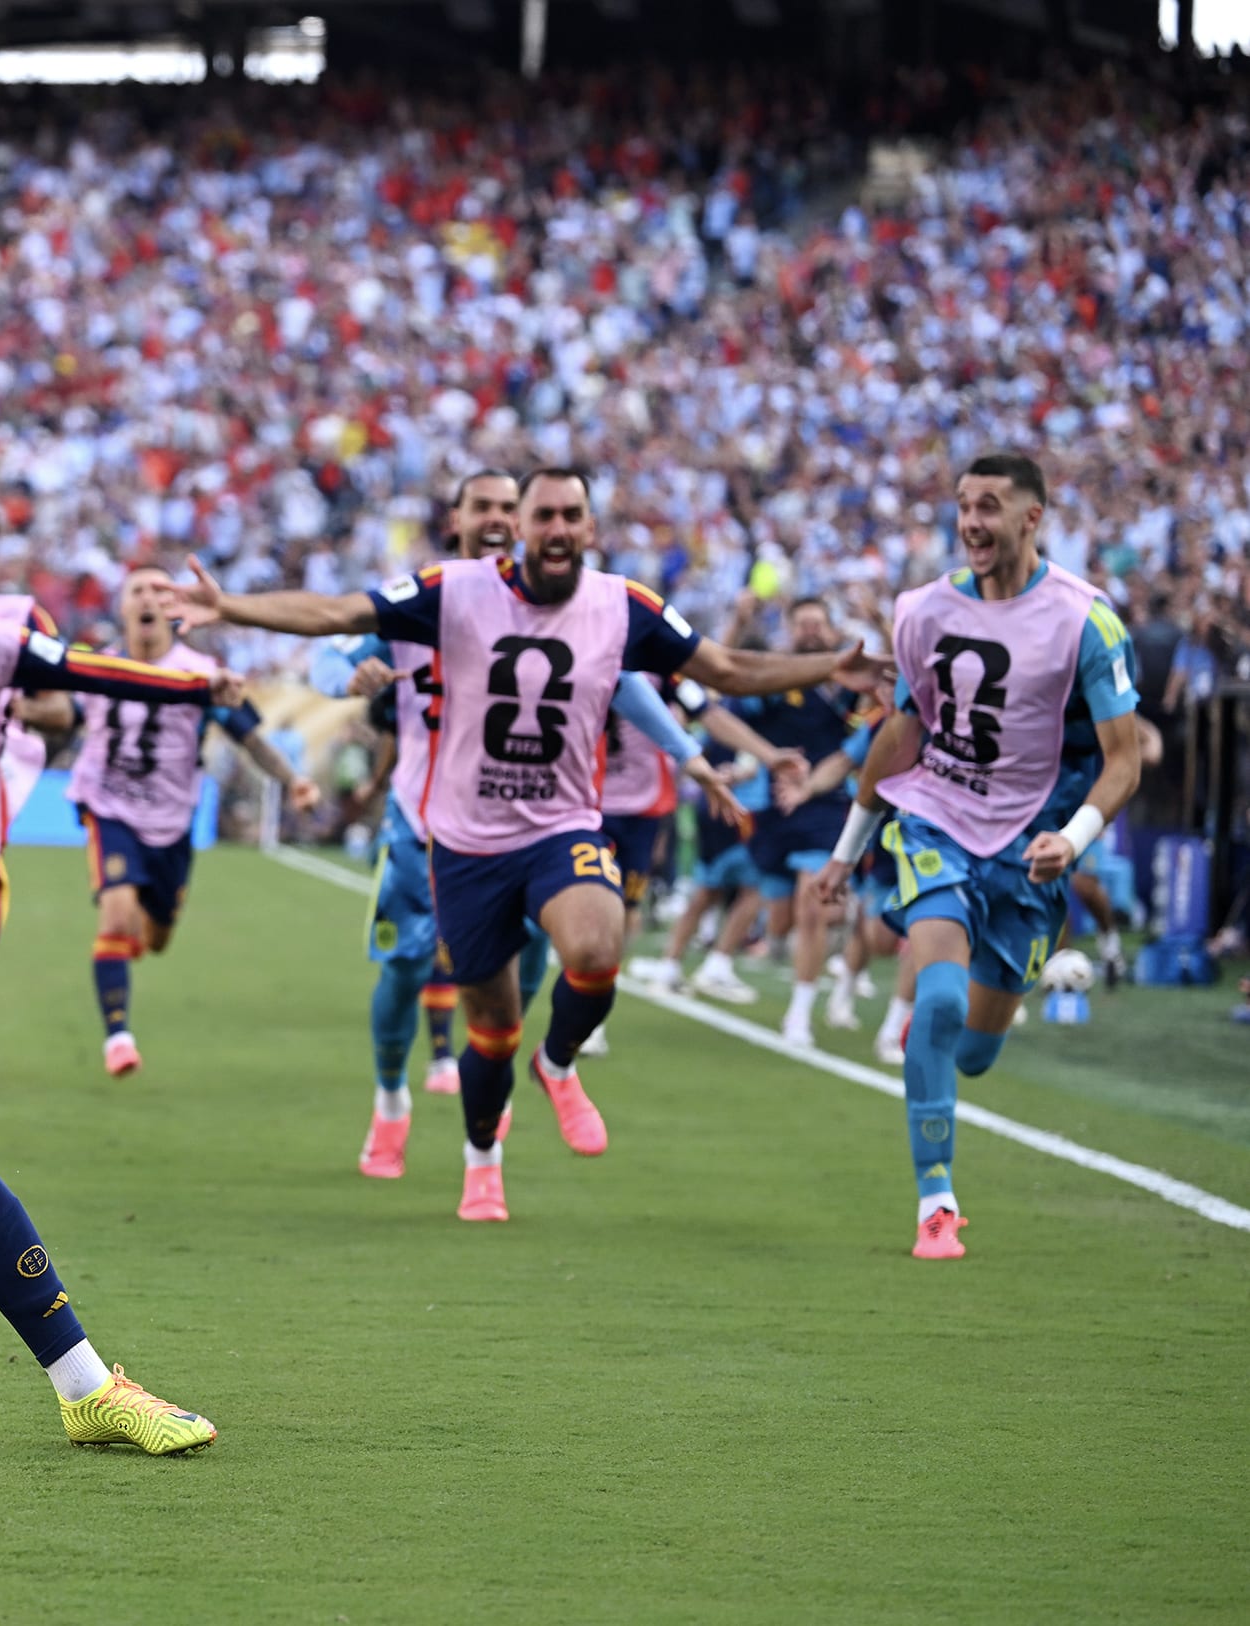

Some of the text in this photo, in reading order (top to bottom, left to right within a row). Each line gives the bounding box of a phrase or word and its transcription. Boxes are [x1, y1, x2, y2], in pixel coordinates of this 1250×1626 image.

[504, 739, 543, 756] FIFA
[478, 781, 557, 801] 2026
[570, 842, 621, 887] 26
